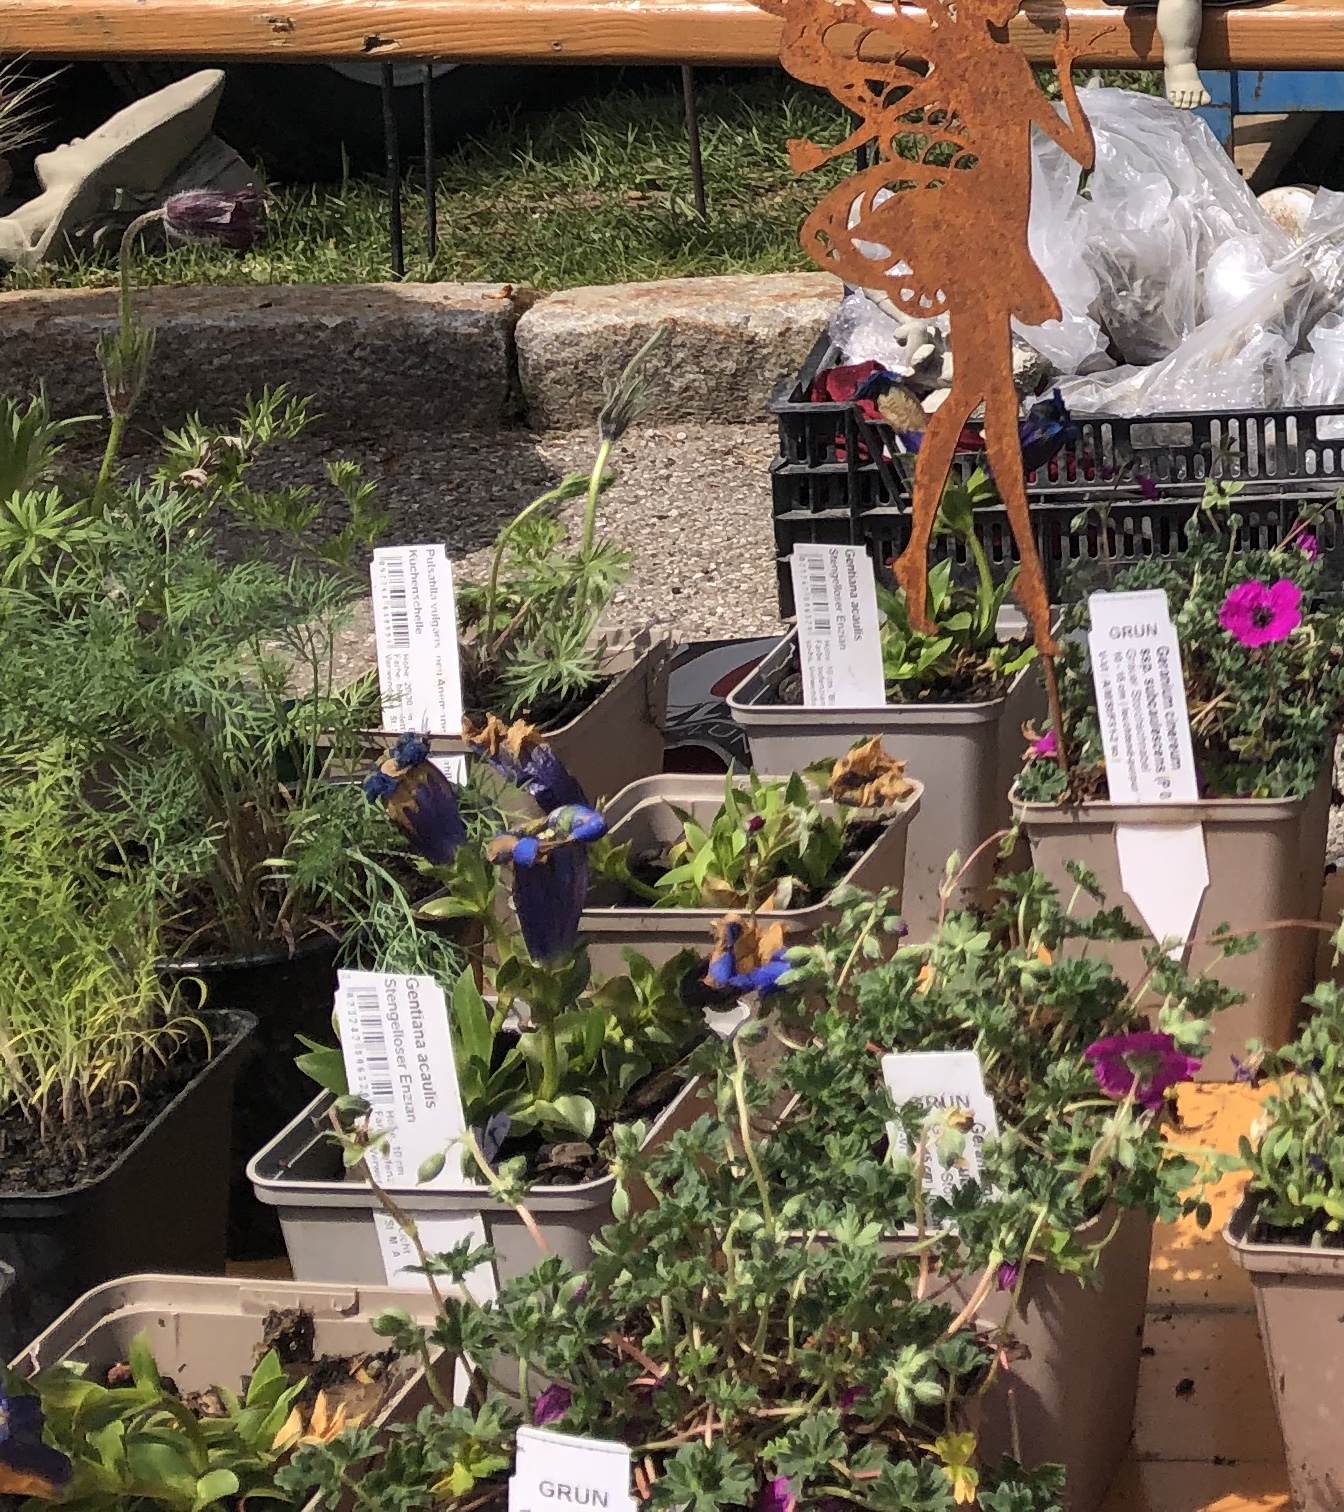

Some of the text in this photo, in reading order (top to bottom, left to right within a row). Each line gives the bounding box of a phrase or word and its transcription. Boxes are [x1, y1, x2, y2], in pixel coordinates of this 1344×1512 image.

[835, 614, 848, 651] Enzian
[844, 548, 864, 641] Gentiana acaulis
[381, 976, 418, 1123] Stengelloser Enzian
[404, 976, 438, 1109] Gentiana acaulis
